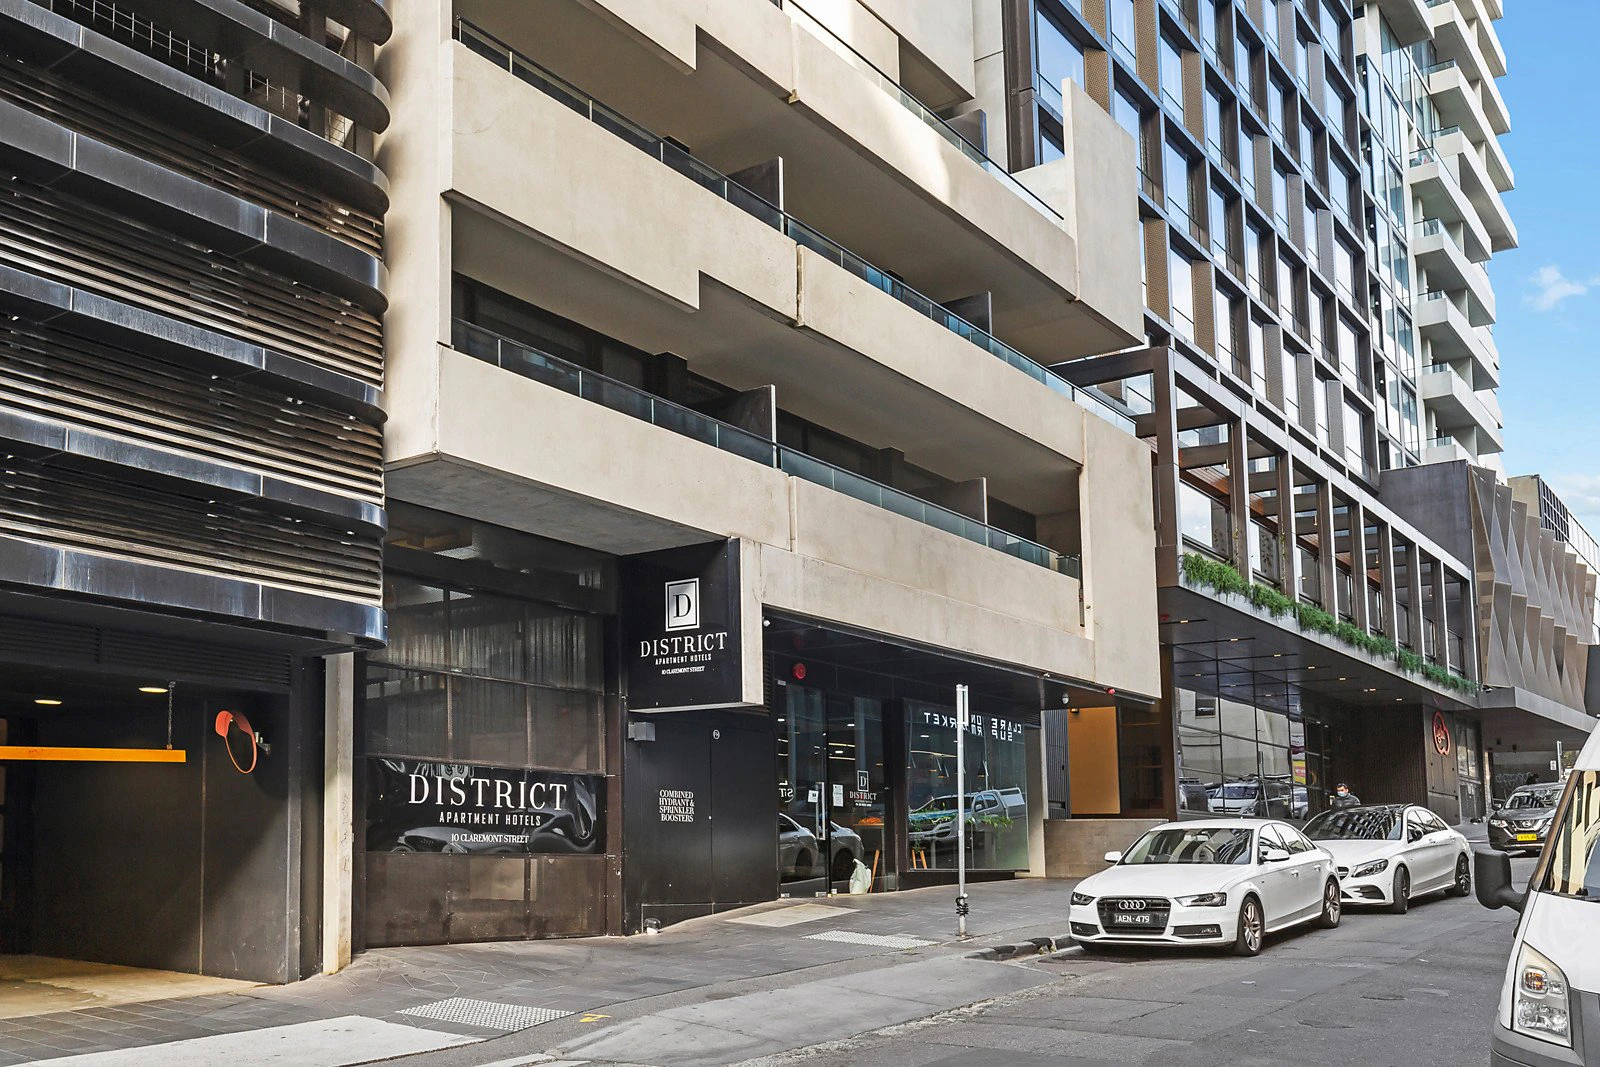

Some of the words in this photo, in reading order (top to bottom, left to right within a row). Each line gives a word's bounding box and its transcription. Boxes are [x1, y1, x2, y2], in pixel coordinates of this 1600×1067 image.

[673, 594, 692, 618] D
[640, 632, 728, 658] DISTRICT
[655, 655, 688, 665] APARTMENT
[690, 653, 712, 662] HOTELS
[408, 773, 568, 812] DISTRICT
[659, 789, 694, 799] COMBINED
[849, 791, 877, 801] DISTRICT
[659, 797, 689, 807] HYDRANT
[689, 799, 695, 807] &
[659, 805, 695, 815] SPRINKLER
[439, 811, 500, 825] APARTMENT
[505, 814, 541, 826] HOTELS
[661, 813, 694, 823] BOOSTERS
[451, 833, 460, 842] 10
[460, 833, 503, 843] CLAREMONT
[503, 834, 530, 844] STREET
